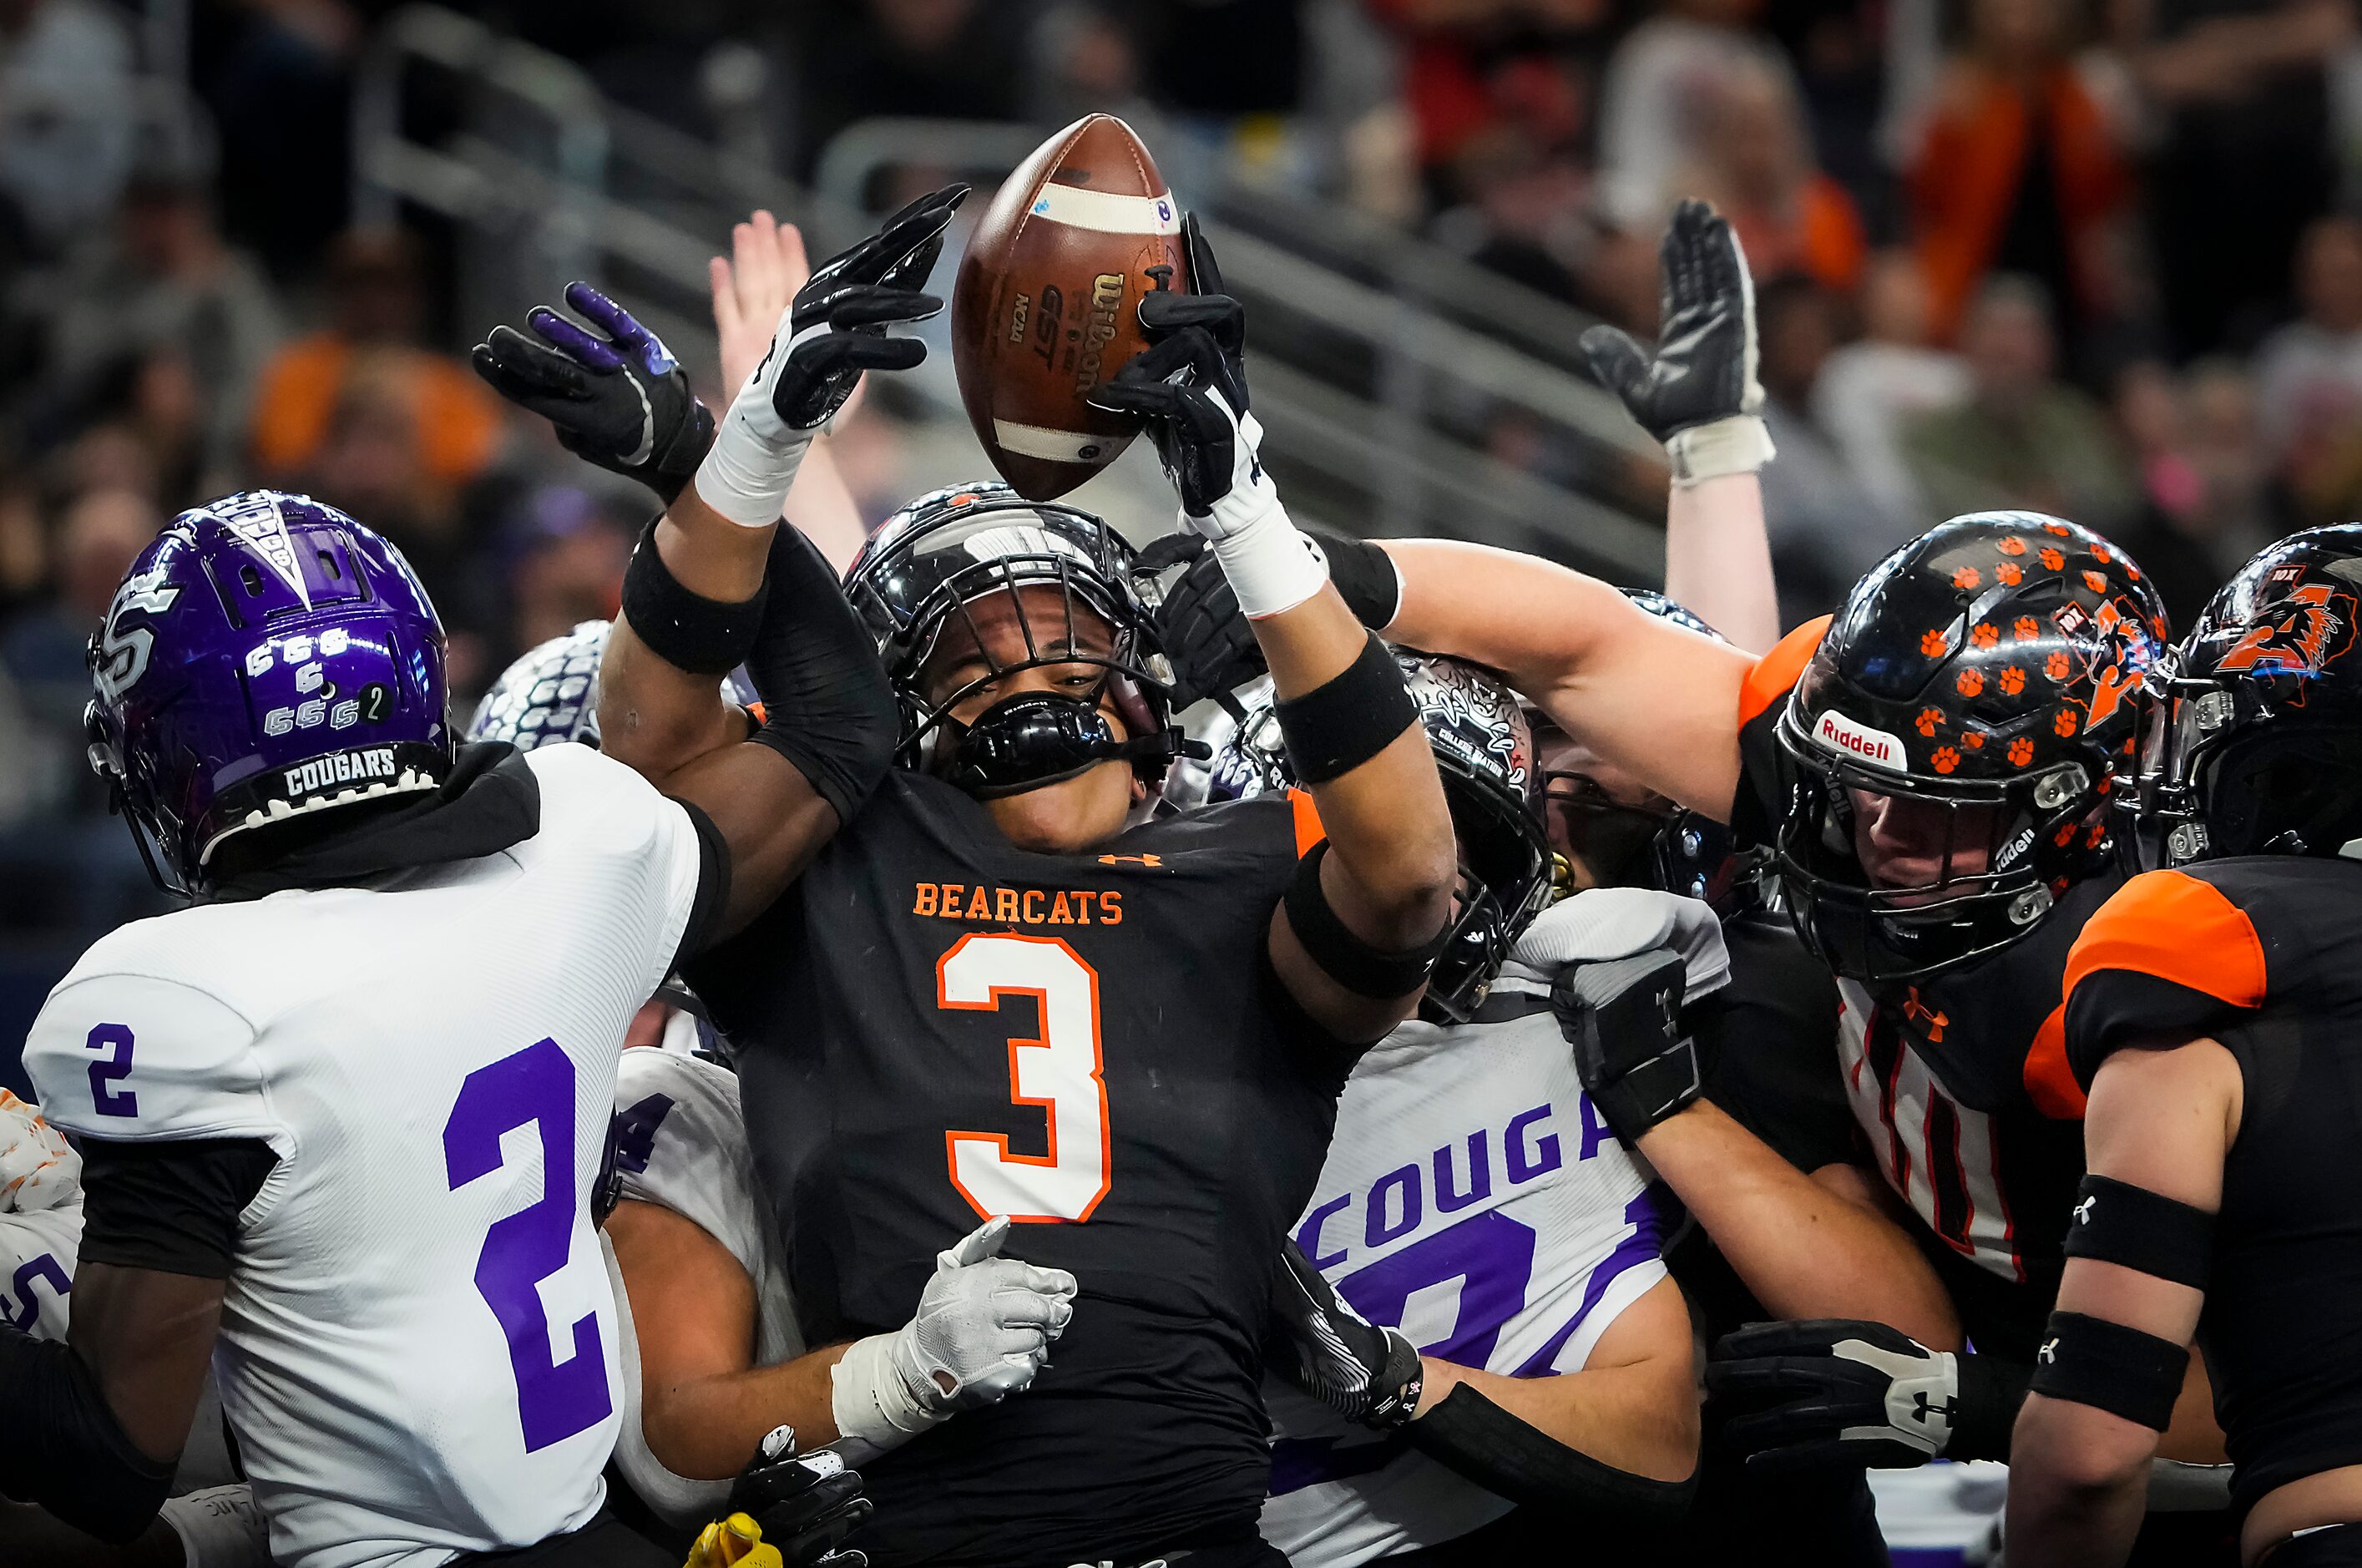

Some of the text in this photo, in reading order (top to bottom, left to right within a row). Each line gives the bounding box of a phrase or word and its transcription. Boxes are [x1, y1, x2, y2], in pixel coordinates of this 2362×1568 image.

[1009, 293, 1030, 343] NCAA
[1075, 274, 1125, 392] Wilson
[367, 686, 383, 721] 2
[1822, 718, 1890, 761] Riddell
[283, 748, 396, 797] COUGARS
[913, 883, 1122, 924] BEARCATS
[85, 1023, 139, 1118] 2
[936, 933, 1112, 1224] 3
[443, 1036, 613, 1454] 2
